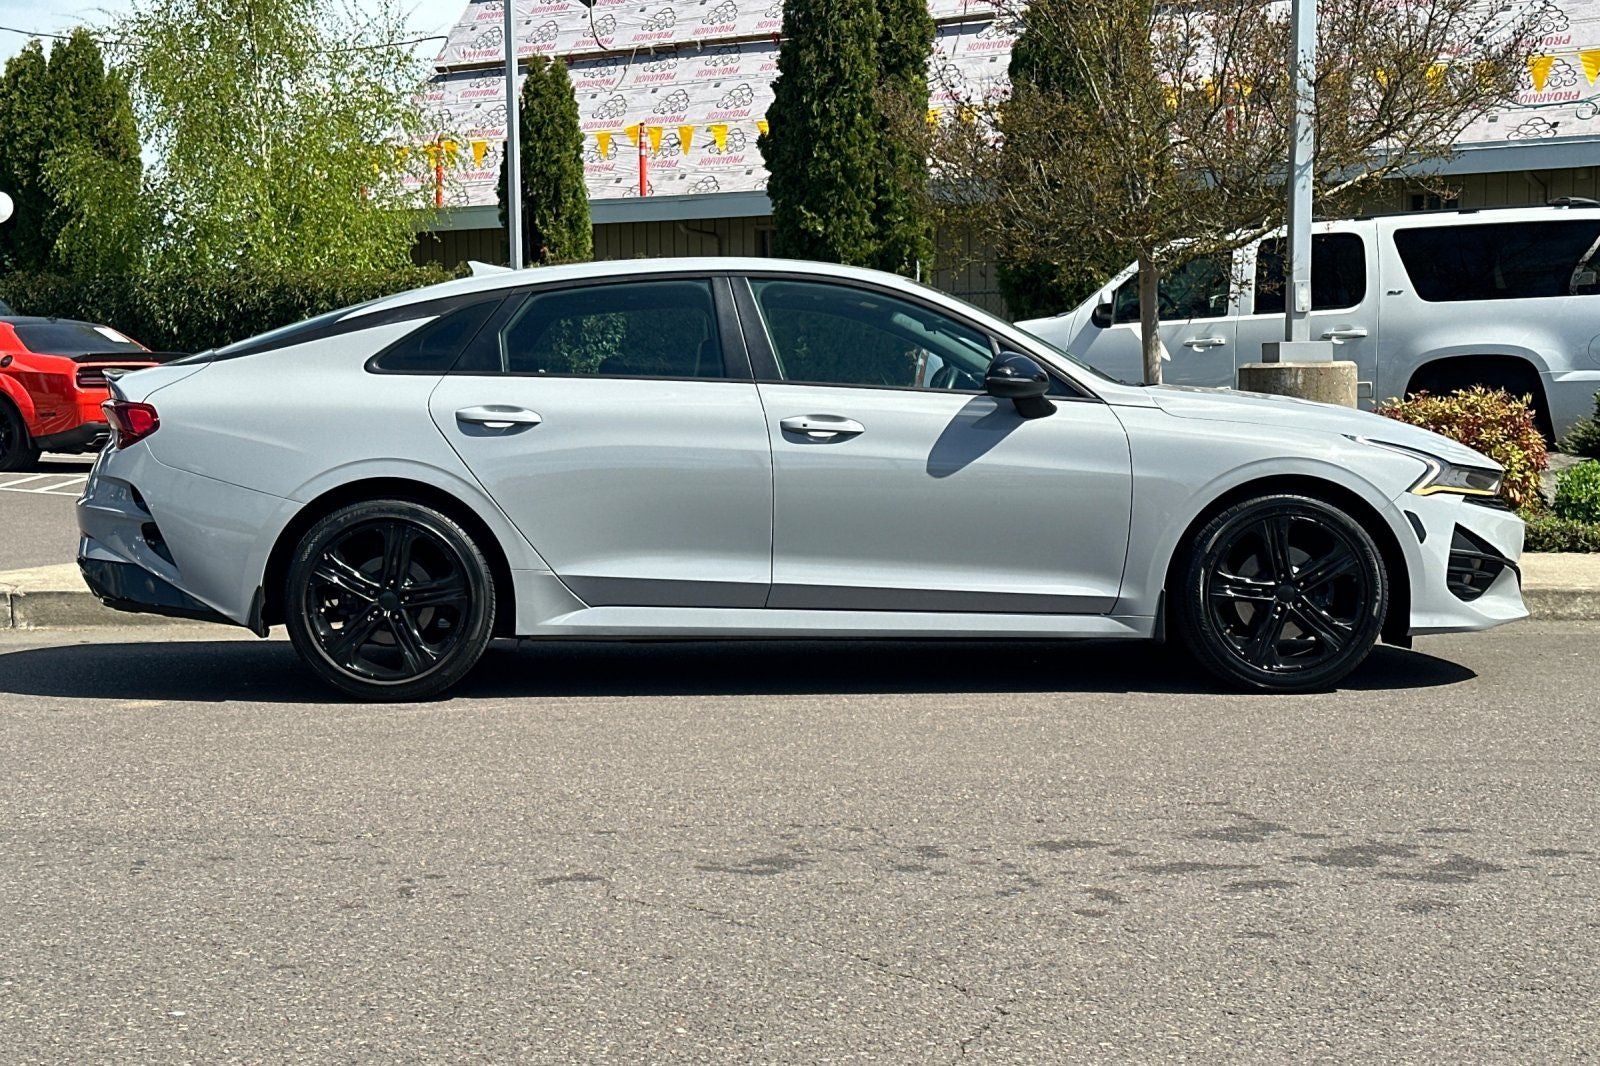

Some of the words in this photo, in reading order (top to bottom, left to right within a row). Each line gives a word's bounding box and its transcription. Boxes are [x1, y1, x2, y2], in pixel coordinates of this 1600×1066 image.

[692, 24, 736, 35] PROARMOR
[755, 20, 783, 29] ARMOR
[632, 30, 674, 41] PROARMOR
[695, 66, 740, 77] PROARMOR
[575, 78, 616, 88] PROARMOR
[634, 72, 677, 83] PROARMOR
[460, 88, 499, 98] PROARMOR
[643, 114, 687, 125] PROARMOR
[705, 109, 750, 120] PROARMOR
[582, 119, 624, 129] PROARMOR
[700, 156, 744, 165] PROARMOR
